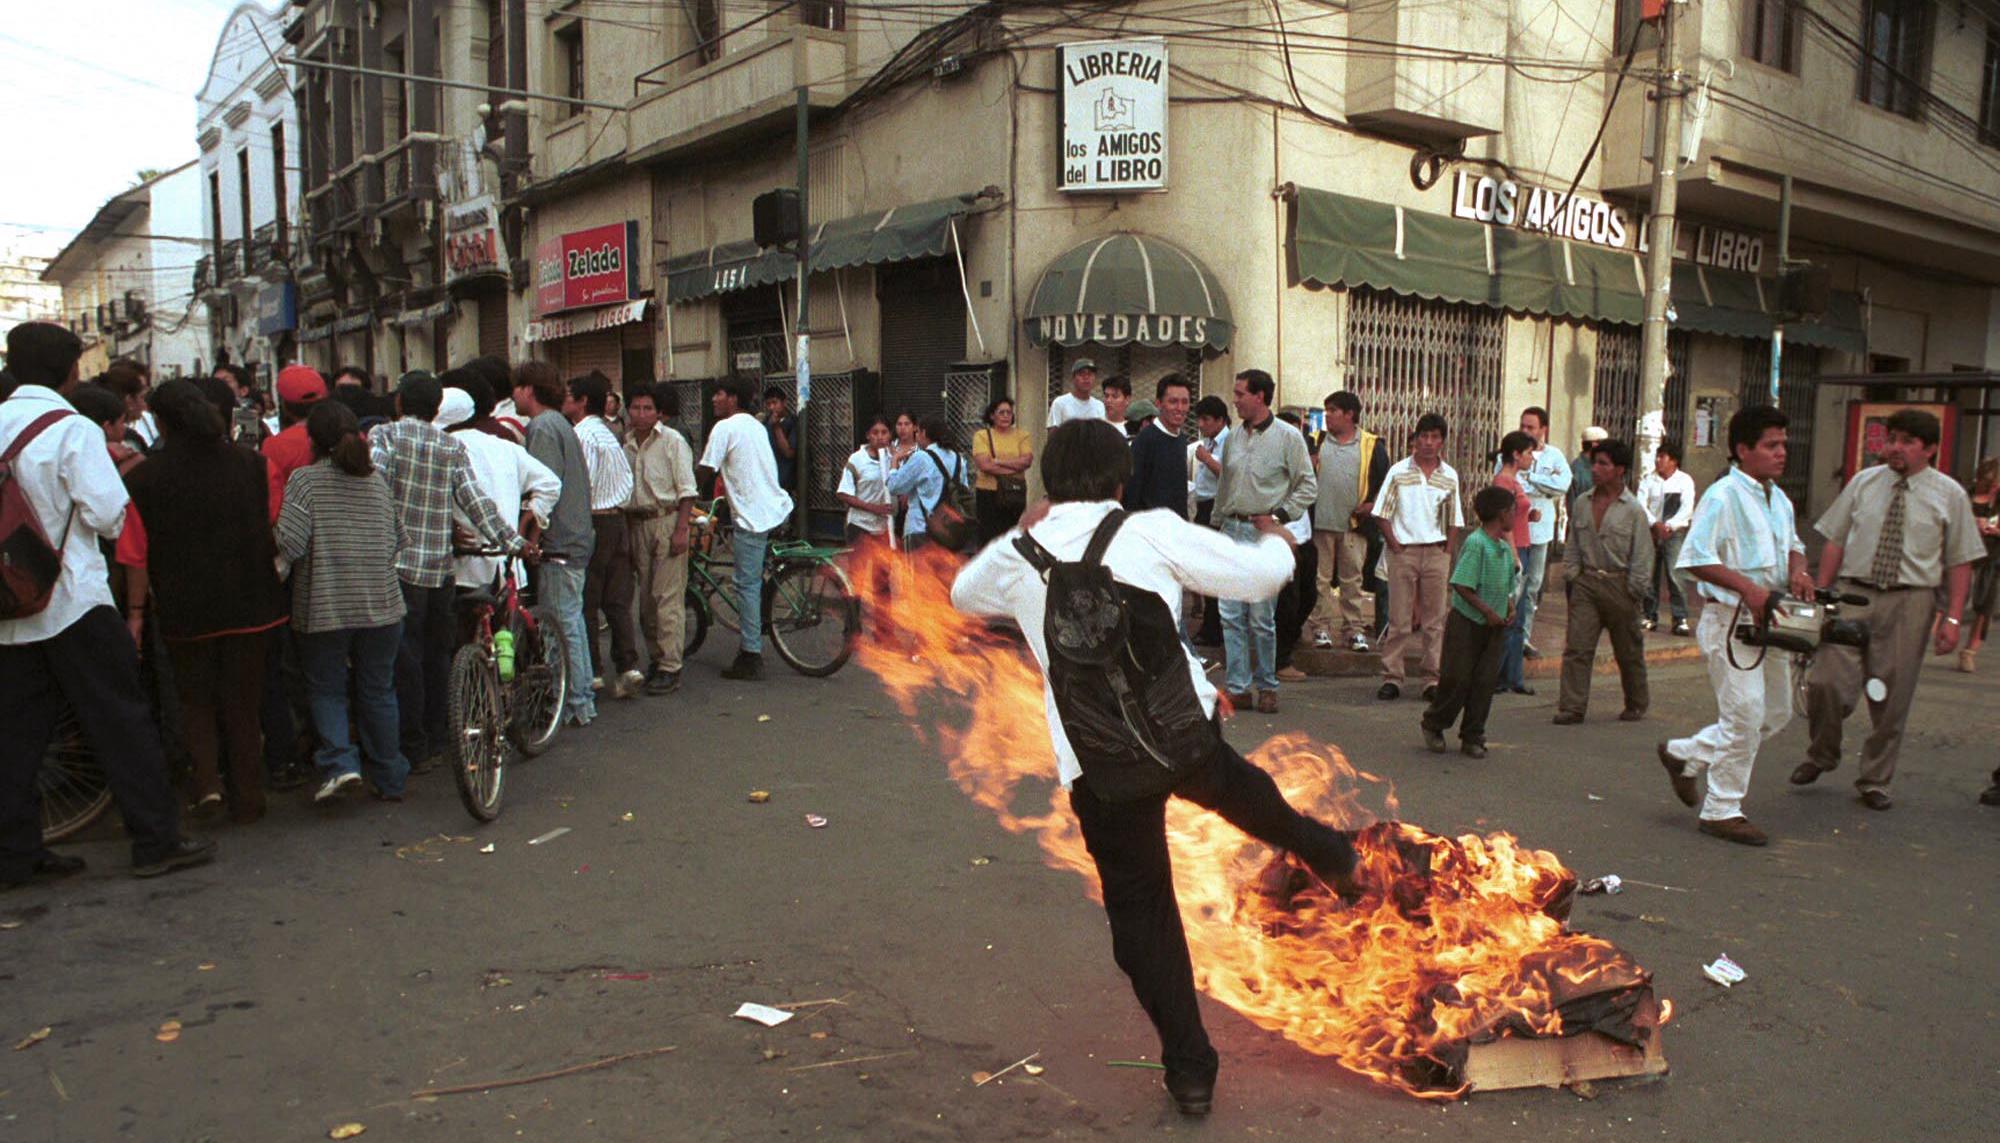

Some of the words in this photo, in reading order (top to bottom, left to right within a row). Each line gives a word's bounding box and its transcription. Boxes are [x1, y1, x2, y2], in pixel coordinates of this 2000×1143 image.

[1066, 51, 1162, 87] LIBRERIA
[1066, 140, 1087, 158] los
[1097, 132, 1162, 156] AMIGOS
[1066, 165, 1087, 183] del
[1096, 158, 1162, 182] LIBRO
[1455, 170, 1517, 225] LOS
[1523, 186, 1627, 248] AMIGOS
[1696, 226, 1764, 273] LIBRO
[568, 243, 620, 280] Zelada
[1040, 314, 1207, 343] NOVEDADES
